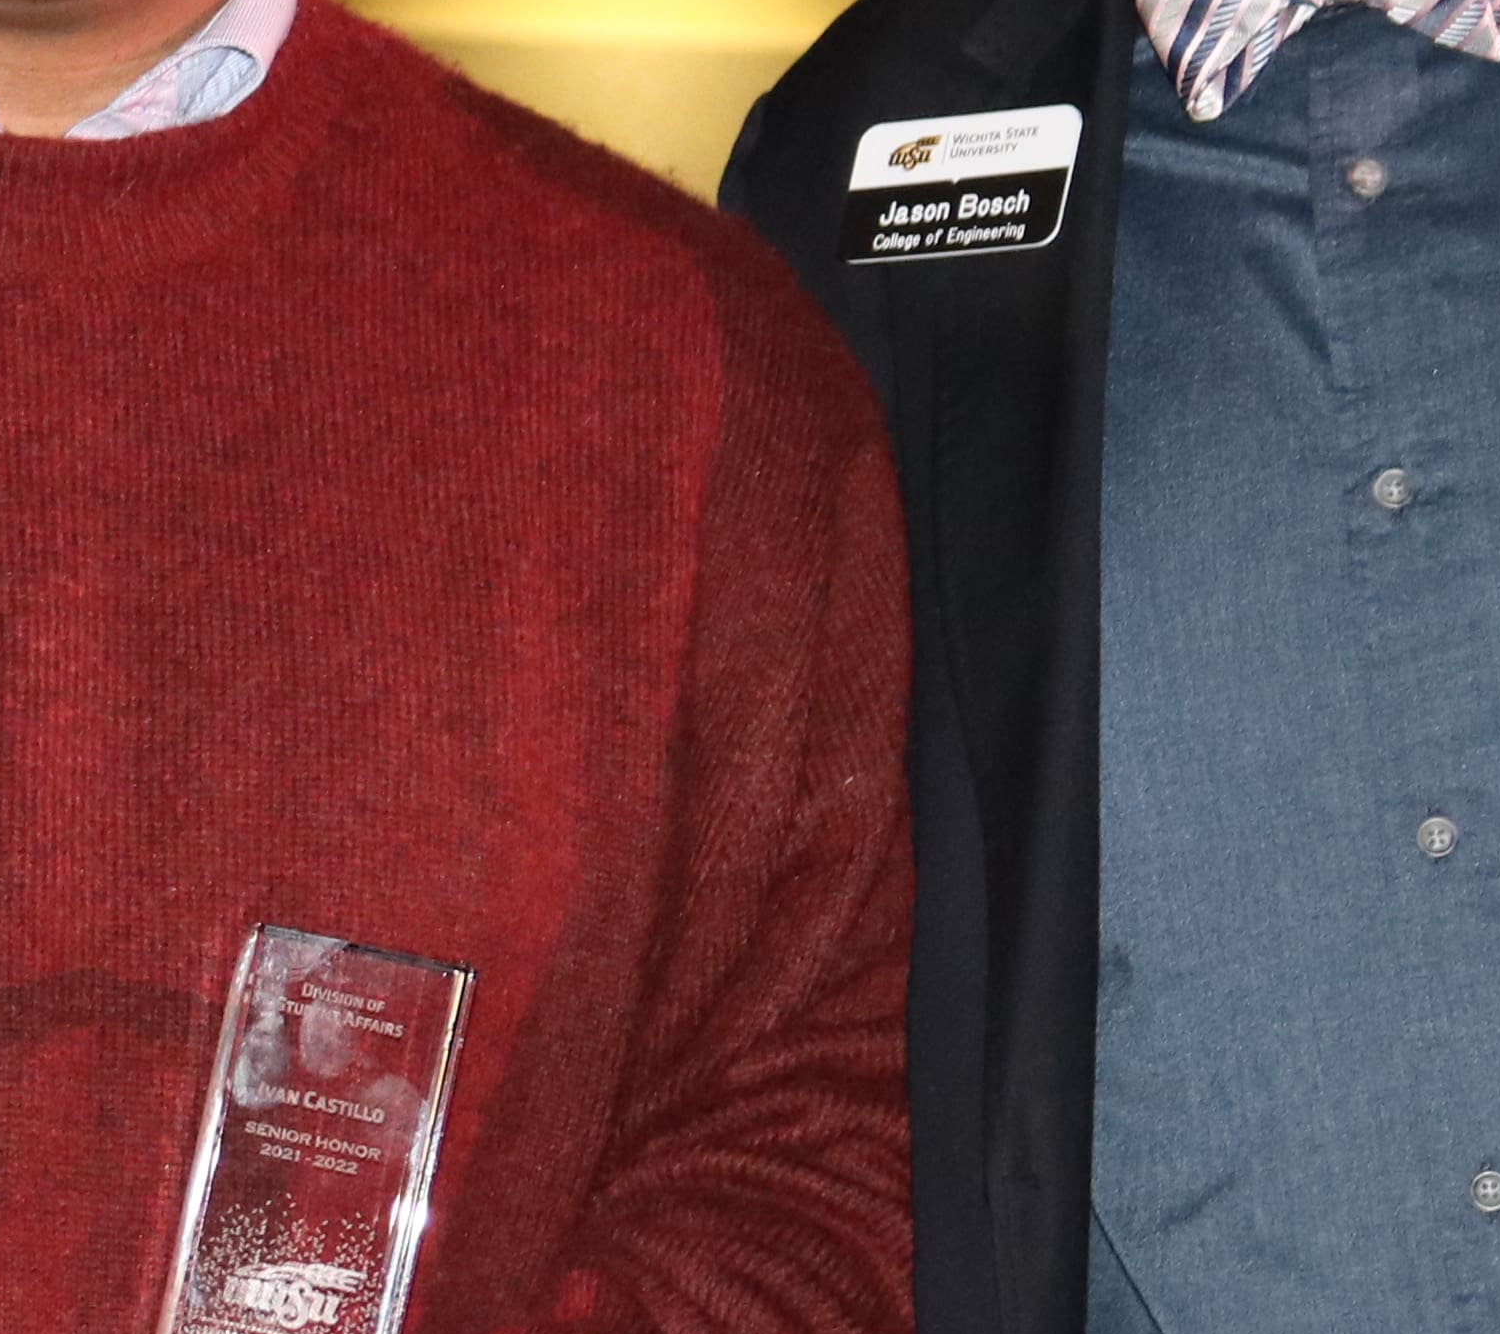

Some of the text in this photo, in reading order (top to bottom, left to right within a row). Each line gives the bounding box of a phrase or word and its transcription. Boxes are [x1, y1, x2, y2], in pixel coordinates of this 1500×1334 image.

[950, 142, 1019, 160] UNIVERSITY
[951, 125, 1040, 146] WICHITA STATE
[878, 187, 1031, 228] Jason Bosch
[872, 221, 1026, 252] College of Engineering
[301, 982, 386, 1013] DIVISION OF
[278, 995, 405, 1039] STUT AFFAIRS
[257, 1080, 386, 1124] IVAN CASTILLO
[244, 1120, 382, 1161] SENIOR HONOR
